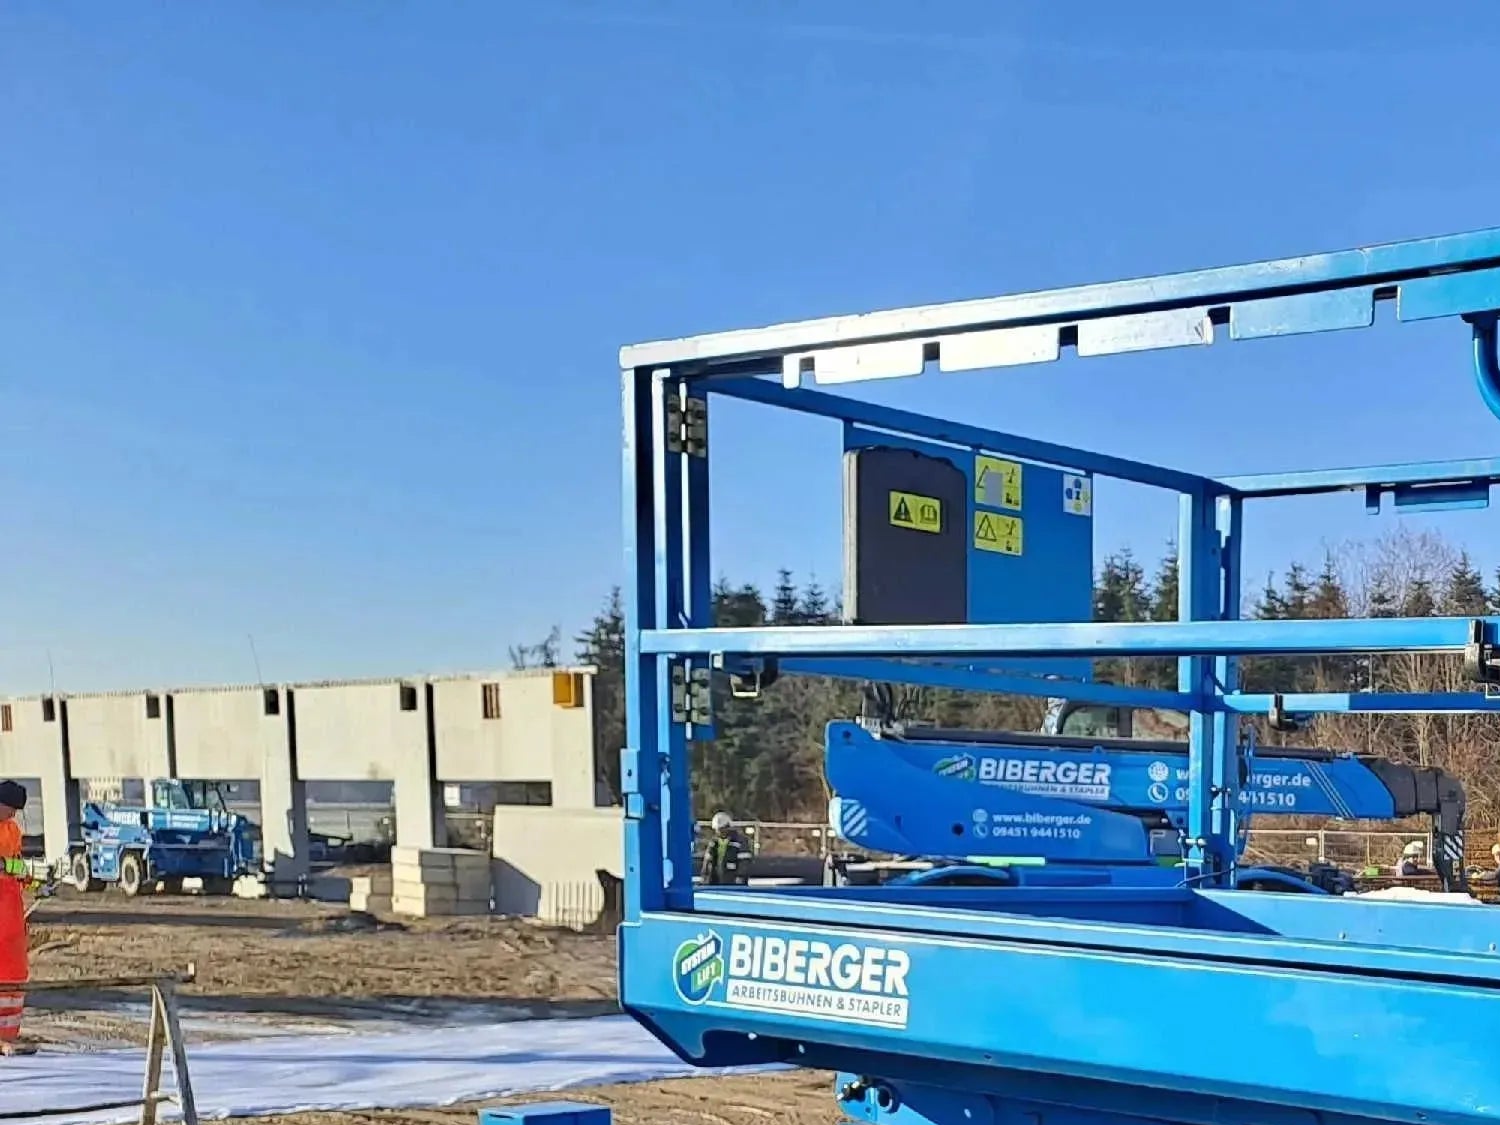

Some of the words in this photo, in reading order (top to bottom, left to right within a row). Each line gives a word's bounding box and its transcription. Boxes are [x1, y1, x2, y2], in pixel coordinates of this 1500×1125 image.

[979, 757, 1112, 785] BIBERGER
[992, 812, 1093, 827] www.biberger.de
[1030, 827, 1081, 839] 9441510
[728, 934, 910, 996] BIBERGER
[836, 996, 846, 1010] &
[848, 997, 903, 1017] STAPLER
